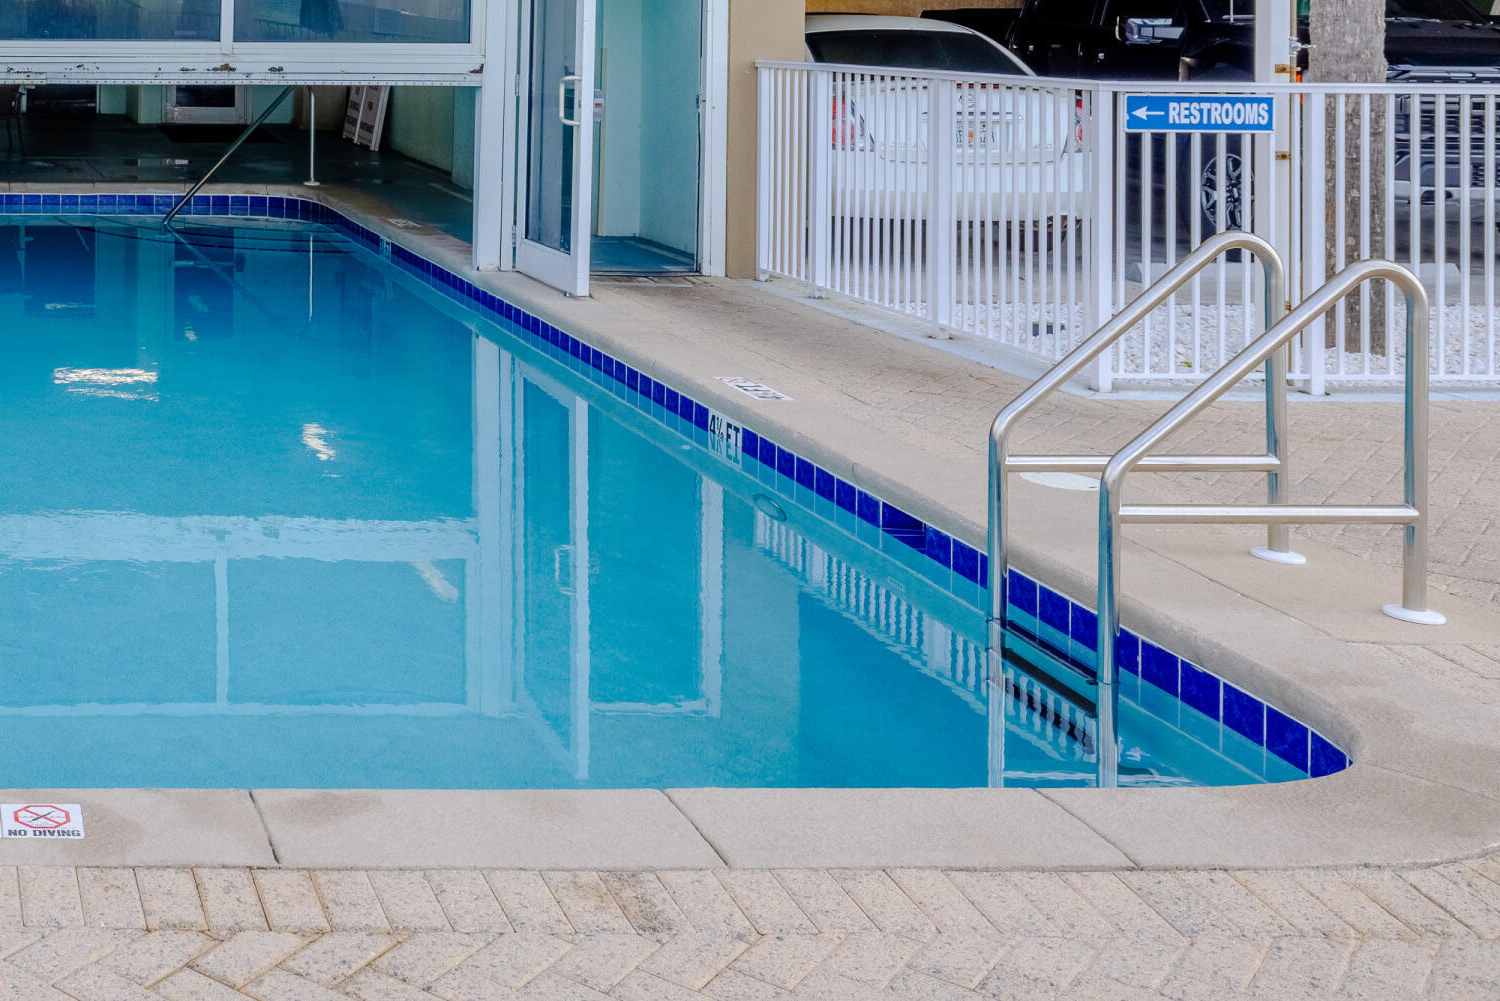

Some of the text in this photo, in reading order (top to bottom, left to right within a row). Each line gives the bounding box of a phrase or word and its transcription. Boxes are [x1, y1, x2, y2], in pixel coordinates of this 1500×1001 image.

[1168, 102, 1269, 125] RESTROOMS
[7, 829, 81, 837] NO DIVING
